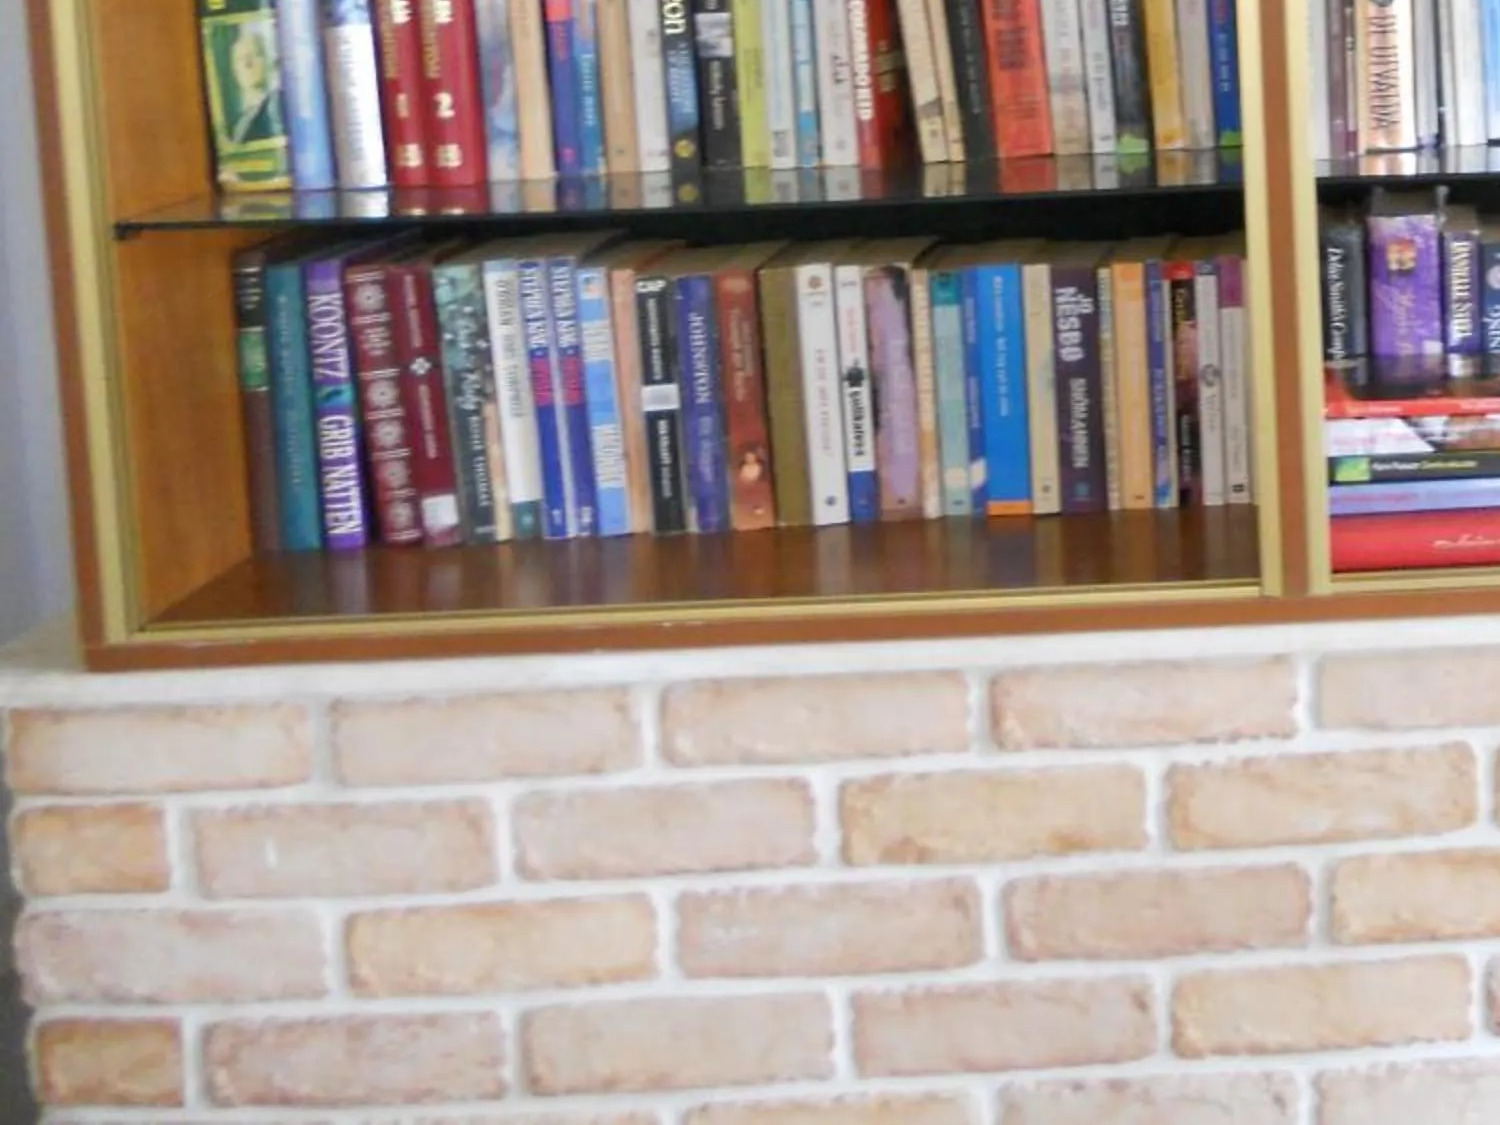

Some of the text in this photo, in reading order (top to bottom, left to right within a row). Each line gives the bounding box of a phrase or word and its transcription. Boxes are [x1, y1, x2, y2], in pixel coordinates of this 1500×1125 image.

[432, 91, 456, 119] 2
[1370, 46, 1401, 133] UTVALDA
[521, 267, 551, 349] STEPHEN KING
[550, 266, 578, 318] STEPHEN
[1054, 286, 1085, 363] NESBØ
[1078, 295, 1095, 315] JO
[687, 312, 713, 405] JOHNSTON
[308, 292, 362, 535] KOONTZ GRIB NATTEN
